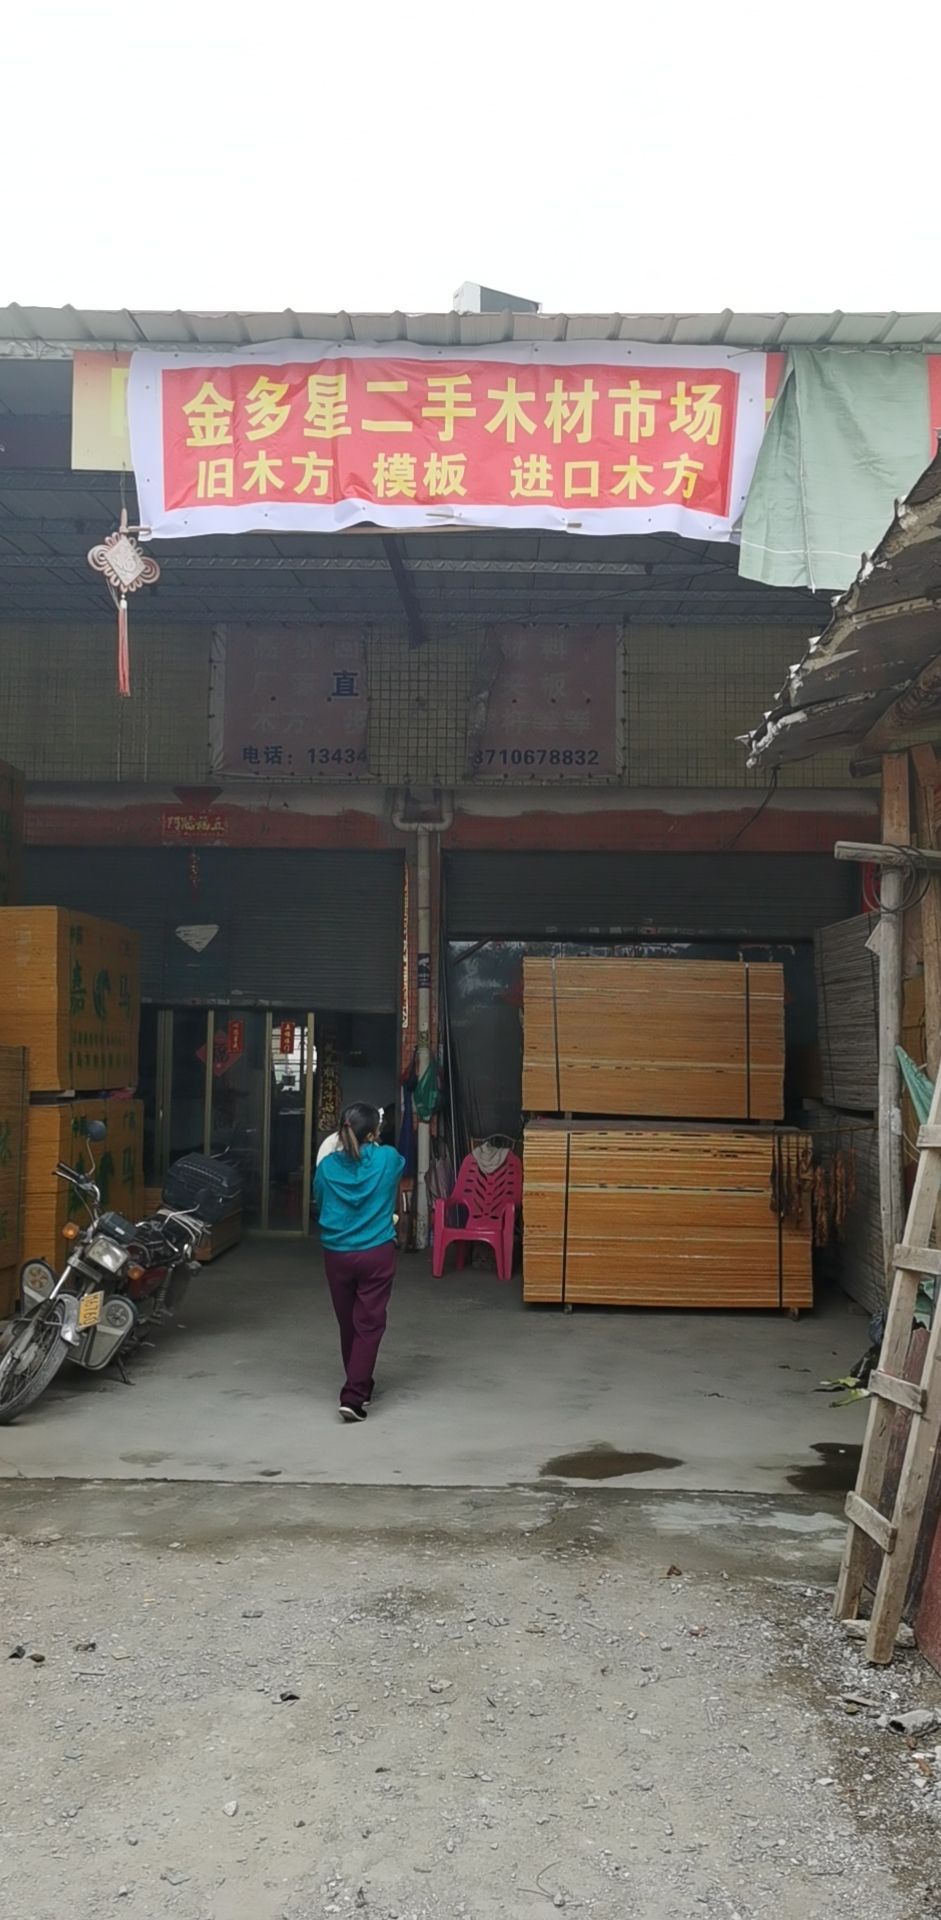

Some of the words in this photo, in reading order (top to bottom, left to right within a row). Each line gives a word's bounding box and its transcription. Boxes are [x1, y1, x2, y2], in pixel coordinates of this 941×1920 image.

[182, 373, 723, 447] 金多星二手木材市场
[196, 451, 335, 499] 旧木方
[372, 452, 468, 498] 模板
[510, 453, 704, 500] 进口木方
[307, 748, 368, 765] 13434
